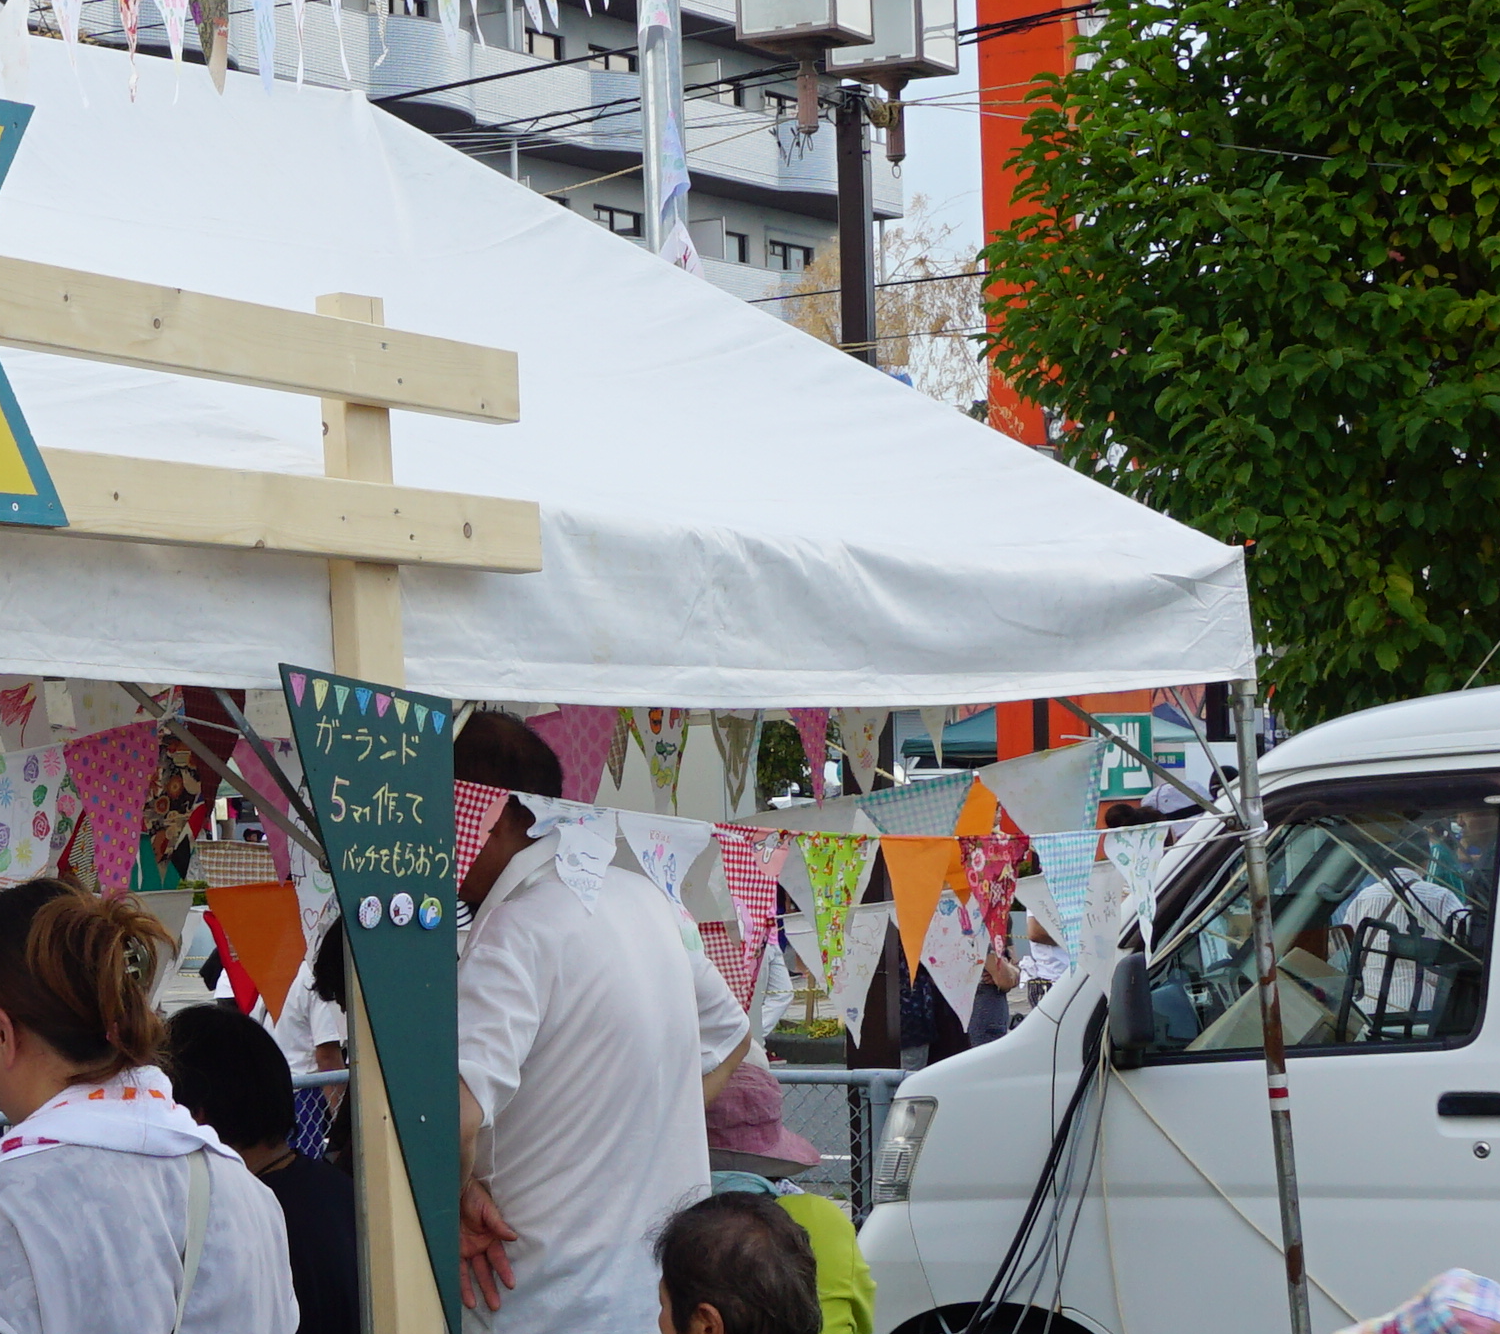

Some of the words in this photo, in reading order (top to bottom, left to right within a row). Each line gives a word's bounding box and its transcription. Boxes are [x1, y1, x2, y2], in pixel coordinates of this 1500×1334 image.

[315, 715, 420, 766] ガーランド
[330, 775, 424, 826] 5マイ作って
